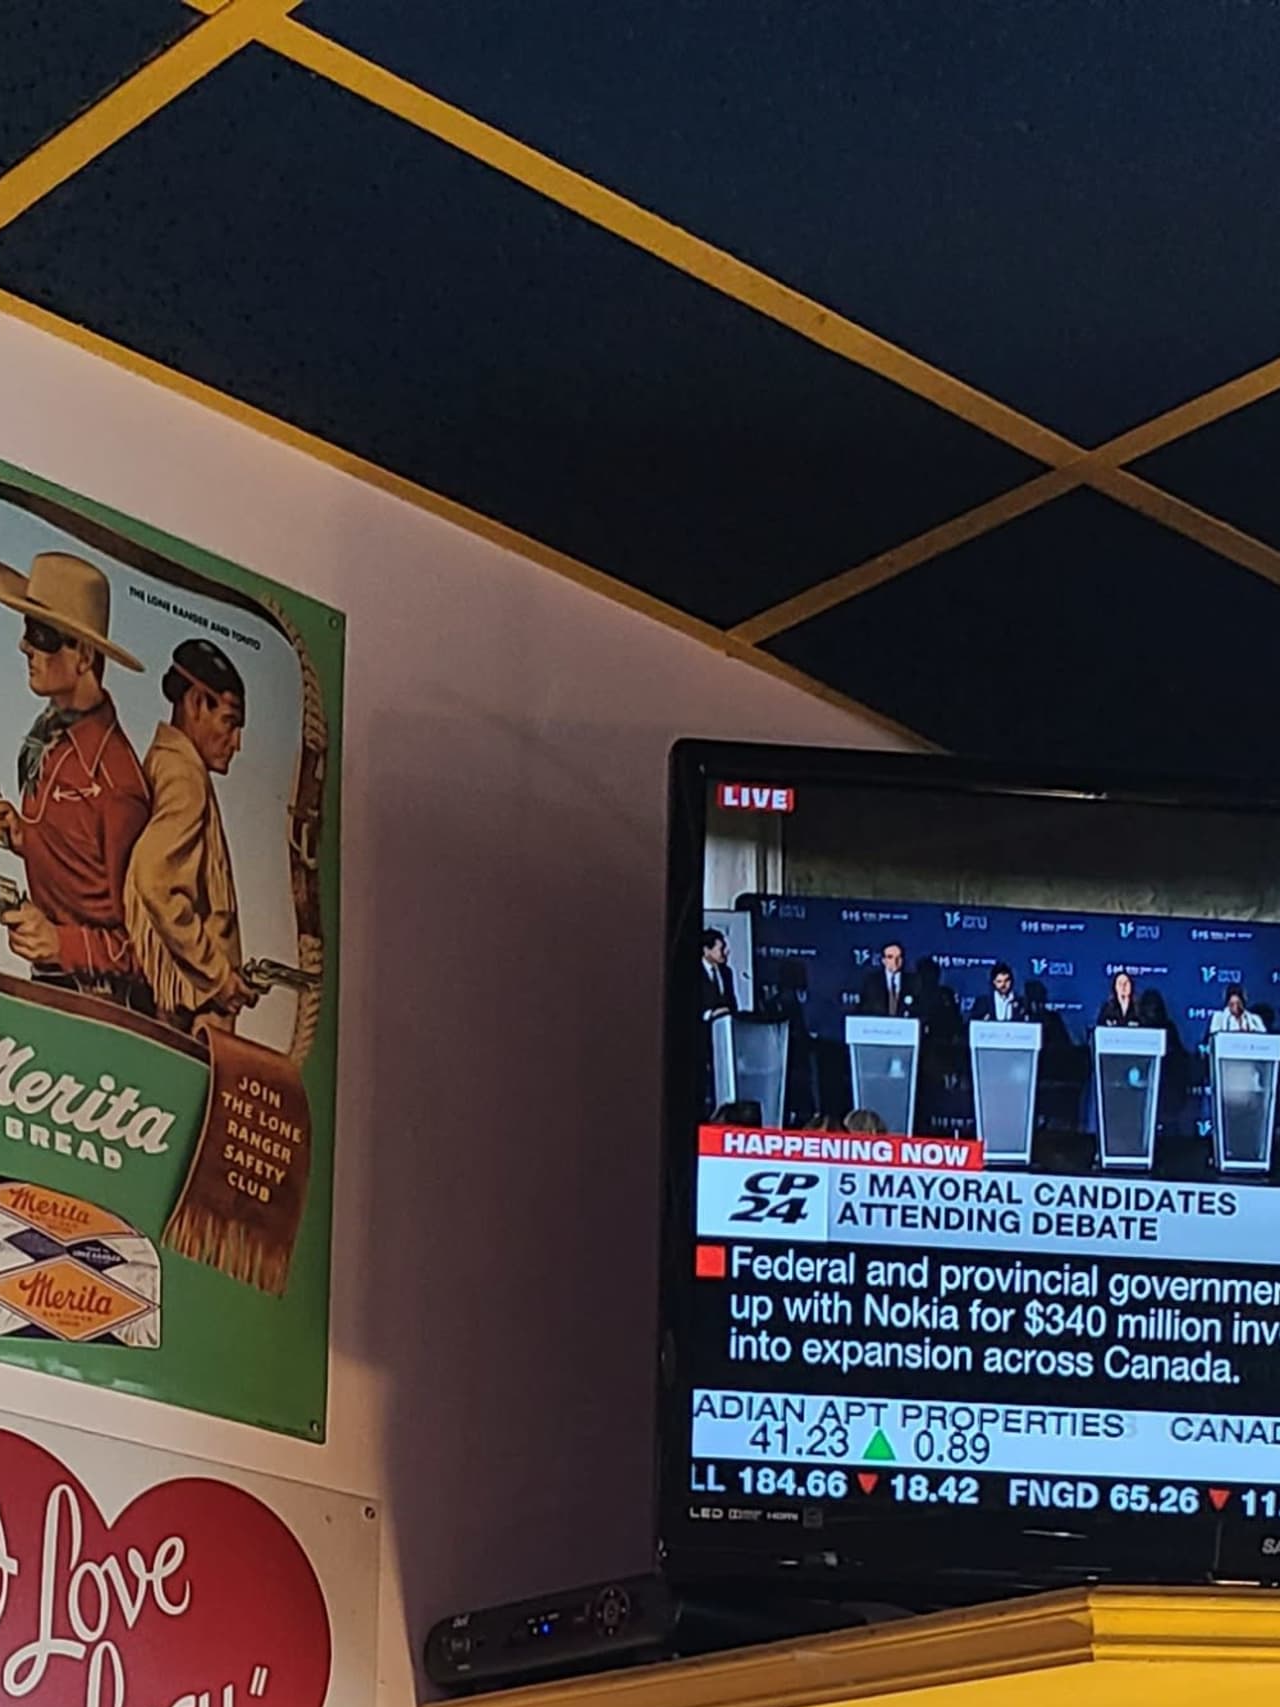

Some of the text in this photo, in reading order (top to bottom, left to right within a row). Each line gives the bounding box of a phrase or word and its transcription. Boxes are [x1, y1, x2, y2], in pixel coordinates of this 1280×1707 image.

[723, 785, 788, 811] LIVE
[221, 1090, 254, 1120] THE
[3, 1114, 123, 1171] BREAD
[724, 1132, 969, 1168] HAPPENING NOW
[223, 1143, 286, 1186] SAFETY
[869, 1174, 1237, 1216] MAYORAL CANDIDATES
[837, 1202, 1021, 1235] ATTENDING
[731, 1245, 855, 1286] Federal
[867, 1254, 929, 1288] and
[940, 1259, 1098, 1299] provincial
[730, 1296, 773, 1327] up
[865, 1294, 960, 1332] Nokia
[970, 1299, 1016, 1332] for
[1024, 1299, 1107, 1338] $340
[1117, 1308, 1222, 1343] million
[729, 1327, 1241, 1385] into expansion Canada.
[817, 1401, 889, 1427] APT
[901, 1403, 1125, 1438] PROPERTIES
[914, 1430, 991, 1463] 0.89
[738, 1466, 848, 1498] 184.66
[1009, 1478, 1099, 1509] FNGD
[1109, 1485, 1200, 1514] 65.26
[3, 1484, 193, 1697] Love
